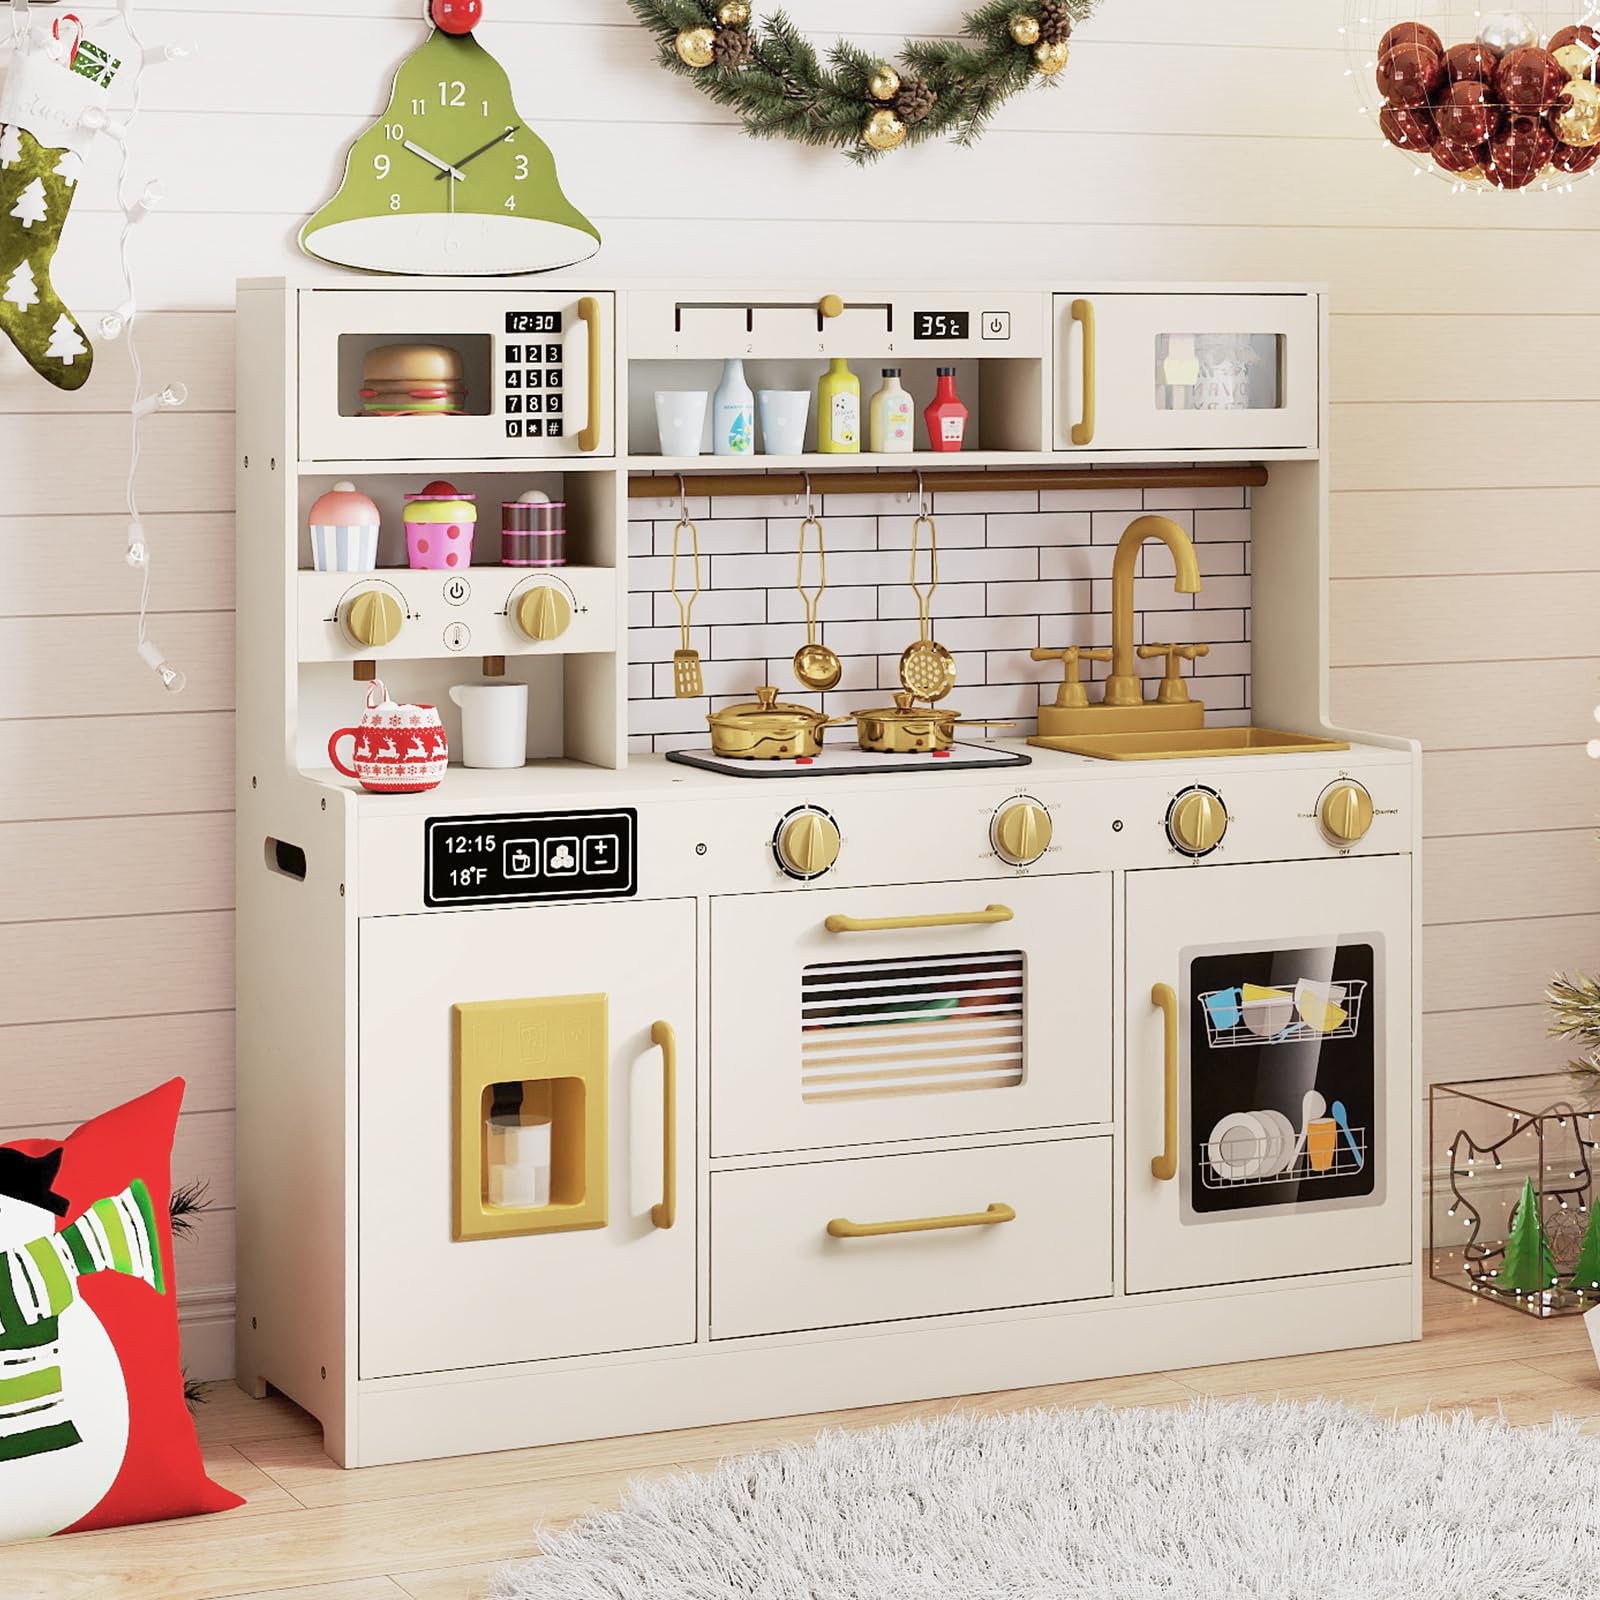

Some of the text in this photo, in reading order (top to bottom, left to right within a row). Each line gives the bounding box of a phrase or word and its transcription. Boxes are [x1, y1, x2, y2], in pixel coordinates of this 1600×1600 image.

[438, 81, 466, 106] 12
[411, 99, 426, 116] 11
[481, 100, 489, 117] 1
[384, 123, 404, 141] 10
[504, 125, 516, 143] 2
[373, 154, 391, 180] 9
[514, 154, 529, 180] 3
[389, 193, 401, 210] 8
[504, 194, 517, 211] 4
[512, 315, 554, 331] 12:30
[511, 346, 559, 361] 1 2 3
[746, 343, 753, 353] 2
[818, 343, 825, 352] 3
[887, 343, 894, 352] 4
[507, 371, 559, 387] 4 5 6
[508, 396, 559, 412] 7 8 9
[445, 835, 497, 854] 12:15
[449, 866, 488, 887] 18°F
